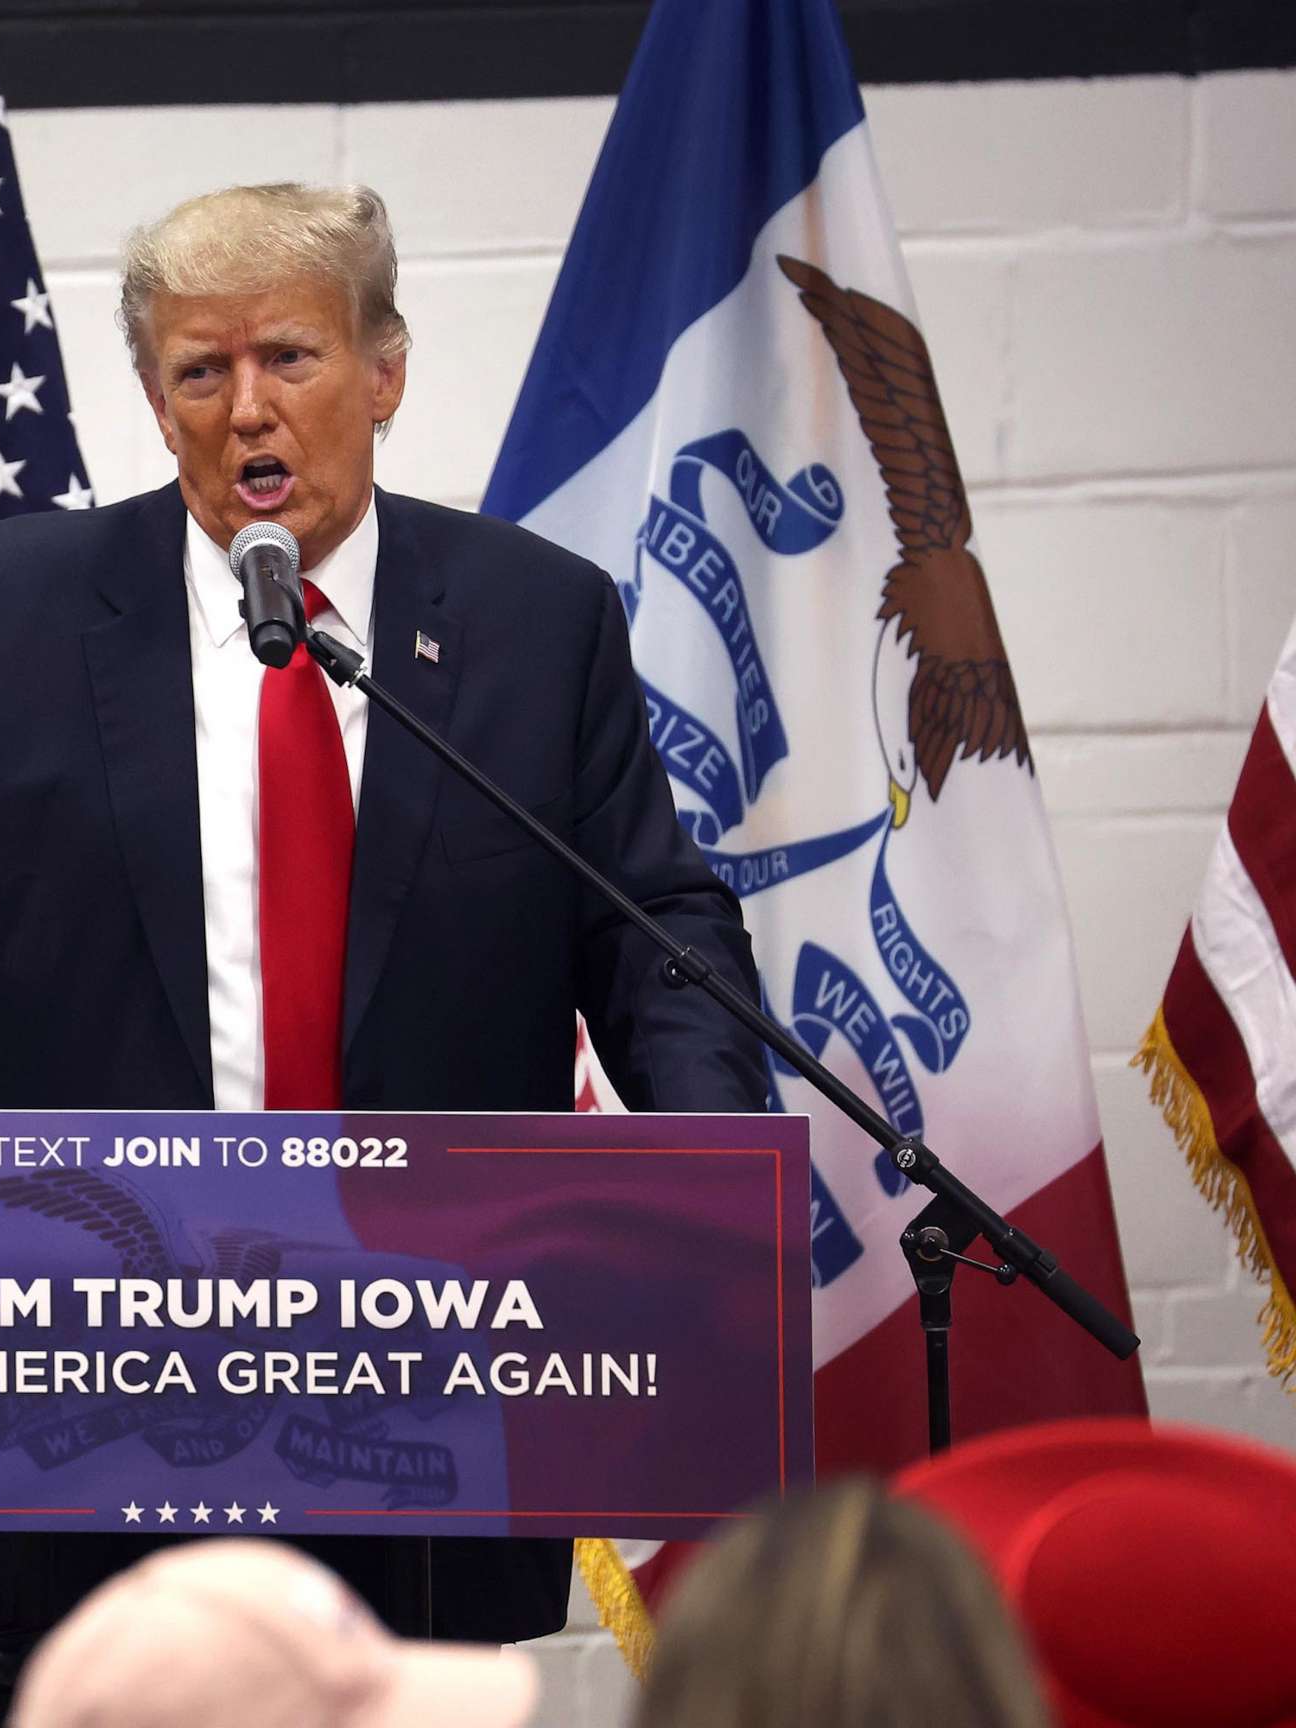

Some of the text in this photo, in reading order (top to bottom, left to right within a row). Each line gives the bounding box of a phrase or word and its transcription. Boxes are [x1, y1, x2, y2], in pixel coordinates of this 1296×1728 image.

[735, 449, 783, 535] OUR
[647, 510, 770, 734] IBERTIES
[739, 850, 790, 891] OUR
[873, 903, 968, 1042] RIGHTS
[814, 969, 873, 1047] WE
[103, 1136, 200, 1168] JOIN
[214, 1136, 267, 1168] TO
[281, 1136, 408, 1168] 88022
[73, 1278, 318, 1328] TRUMP
[340, 1278, 544, 1329] IOWA
[217, 1350, 423, 1395] GREAT
[443, 1352, 657, 1397] AGAIN!
[44, 1418, 98, 1458] WE
[175, 1438, 226, 1464] AND
[289, 1423, 448, 1478] MAINTAIN
